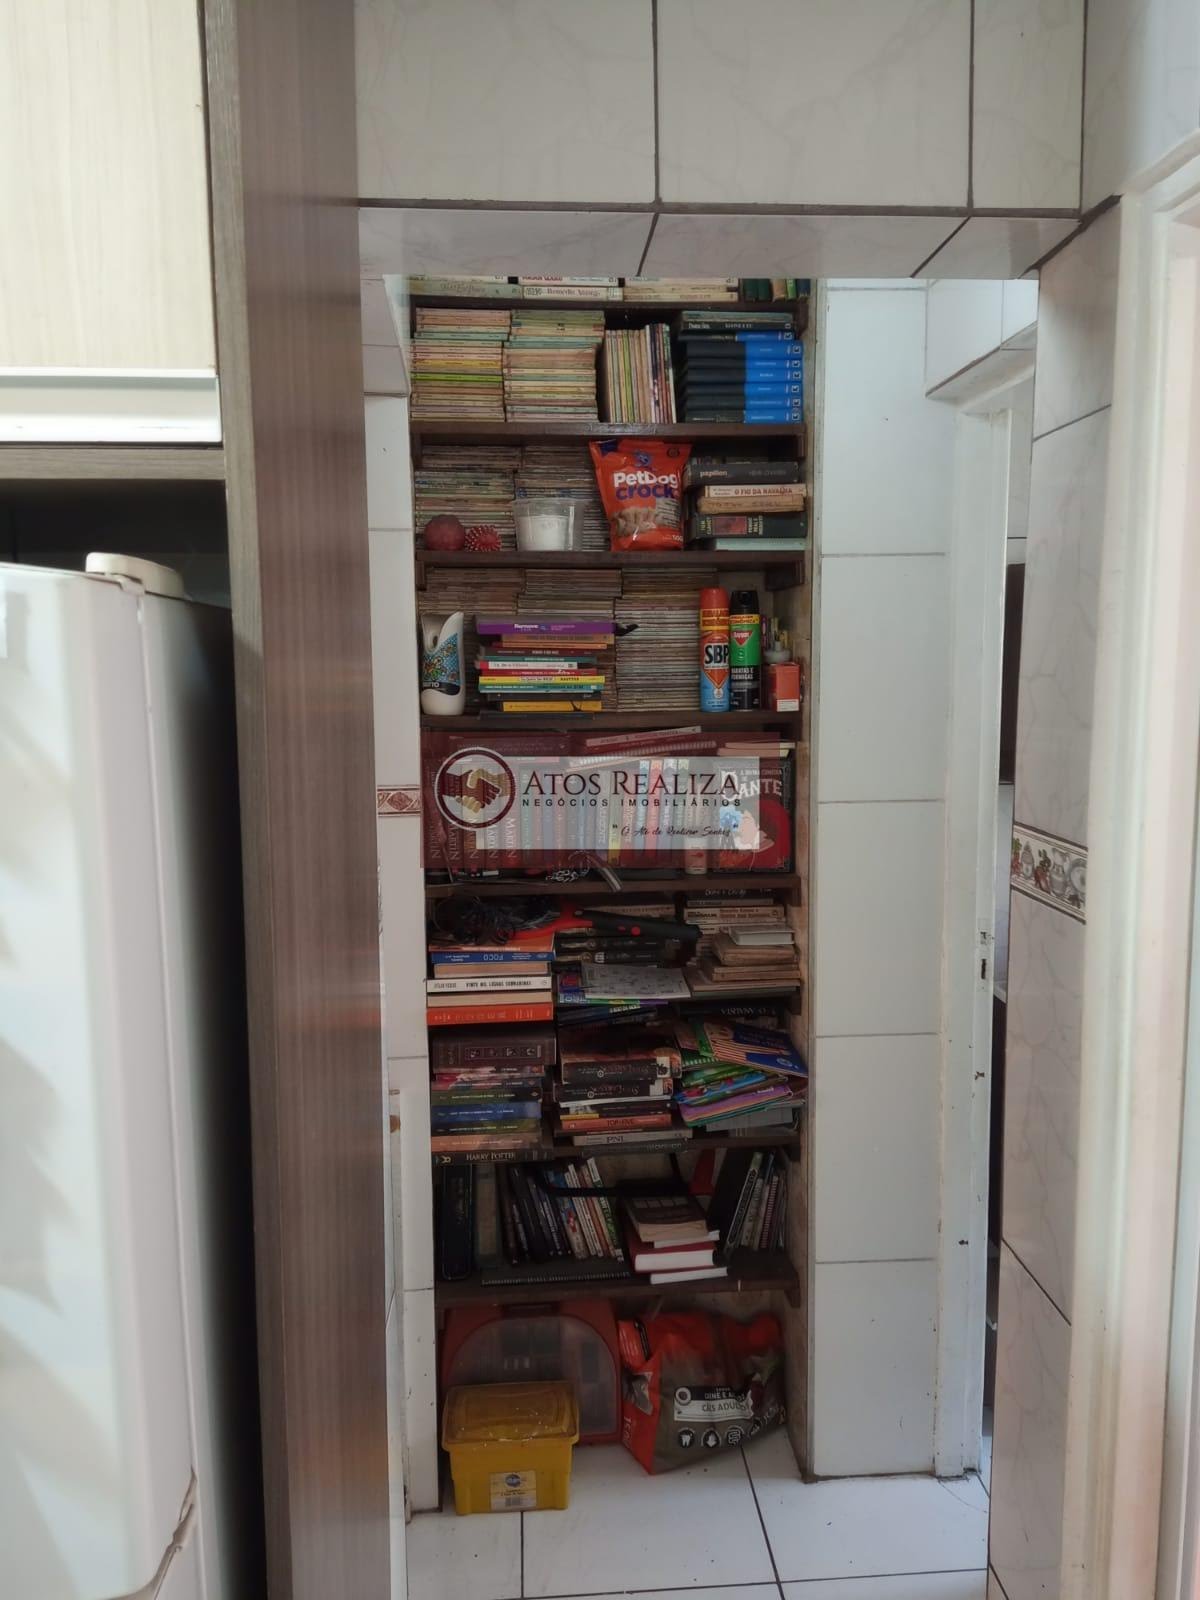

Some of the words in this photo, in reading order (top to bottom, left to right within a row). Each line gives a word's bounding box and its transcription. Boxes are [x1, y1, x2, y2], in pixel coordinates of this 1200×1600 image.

[613, 470, 679, 489] PetDog
[700, 469, 728, 478] papillon
[616, 485, 674, 500] crock
[705, 644, 729, 664] SBP
[505, 818, 516, 858] MARTIN
[483, 953, 504, 962] FOCO
[466, 1152, 489, 1161] HARRY
[490, 1151, 516, 1160] POTTER
